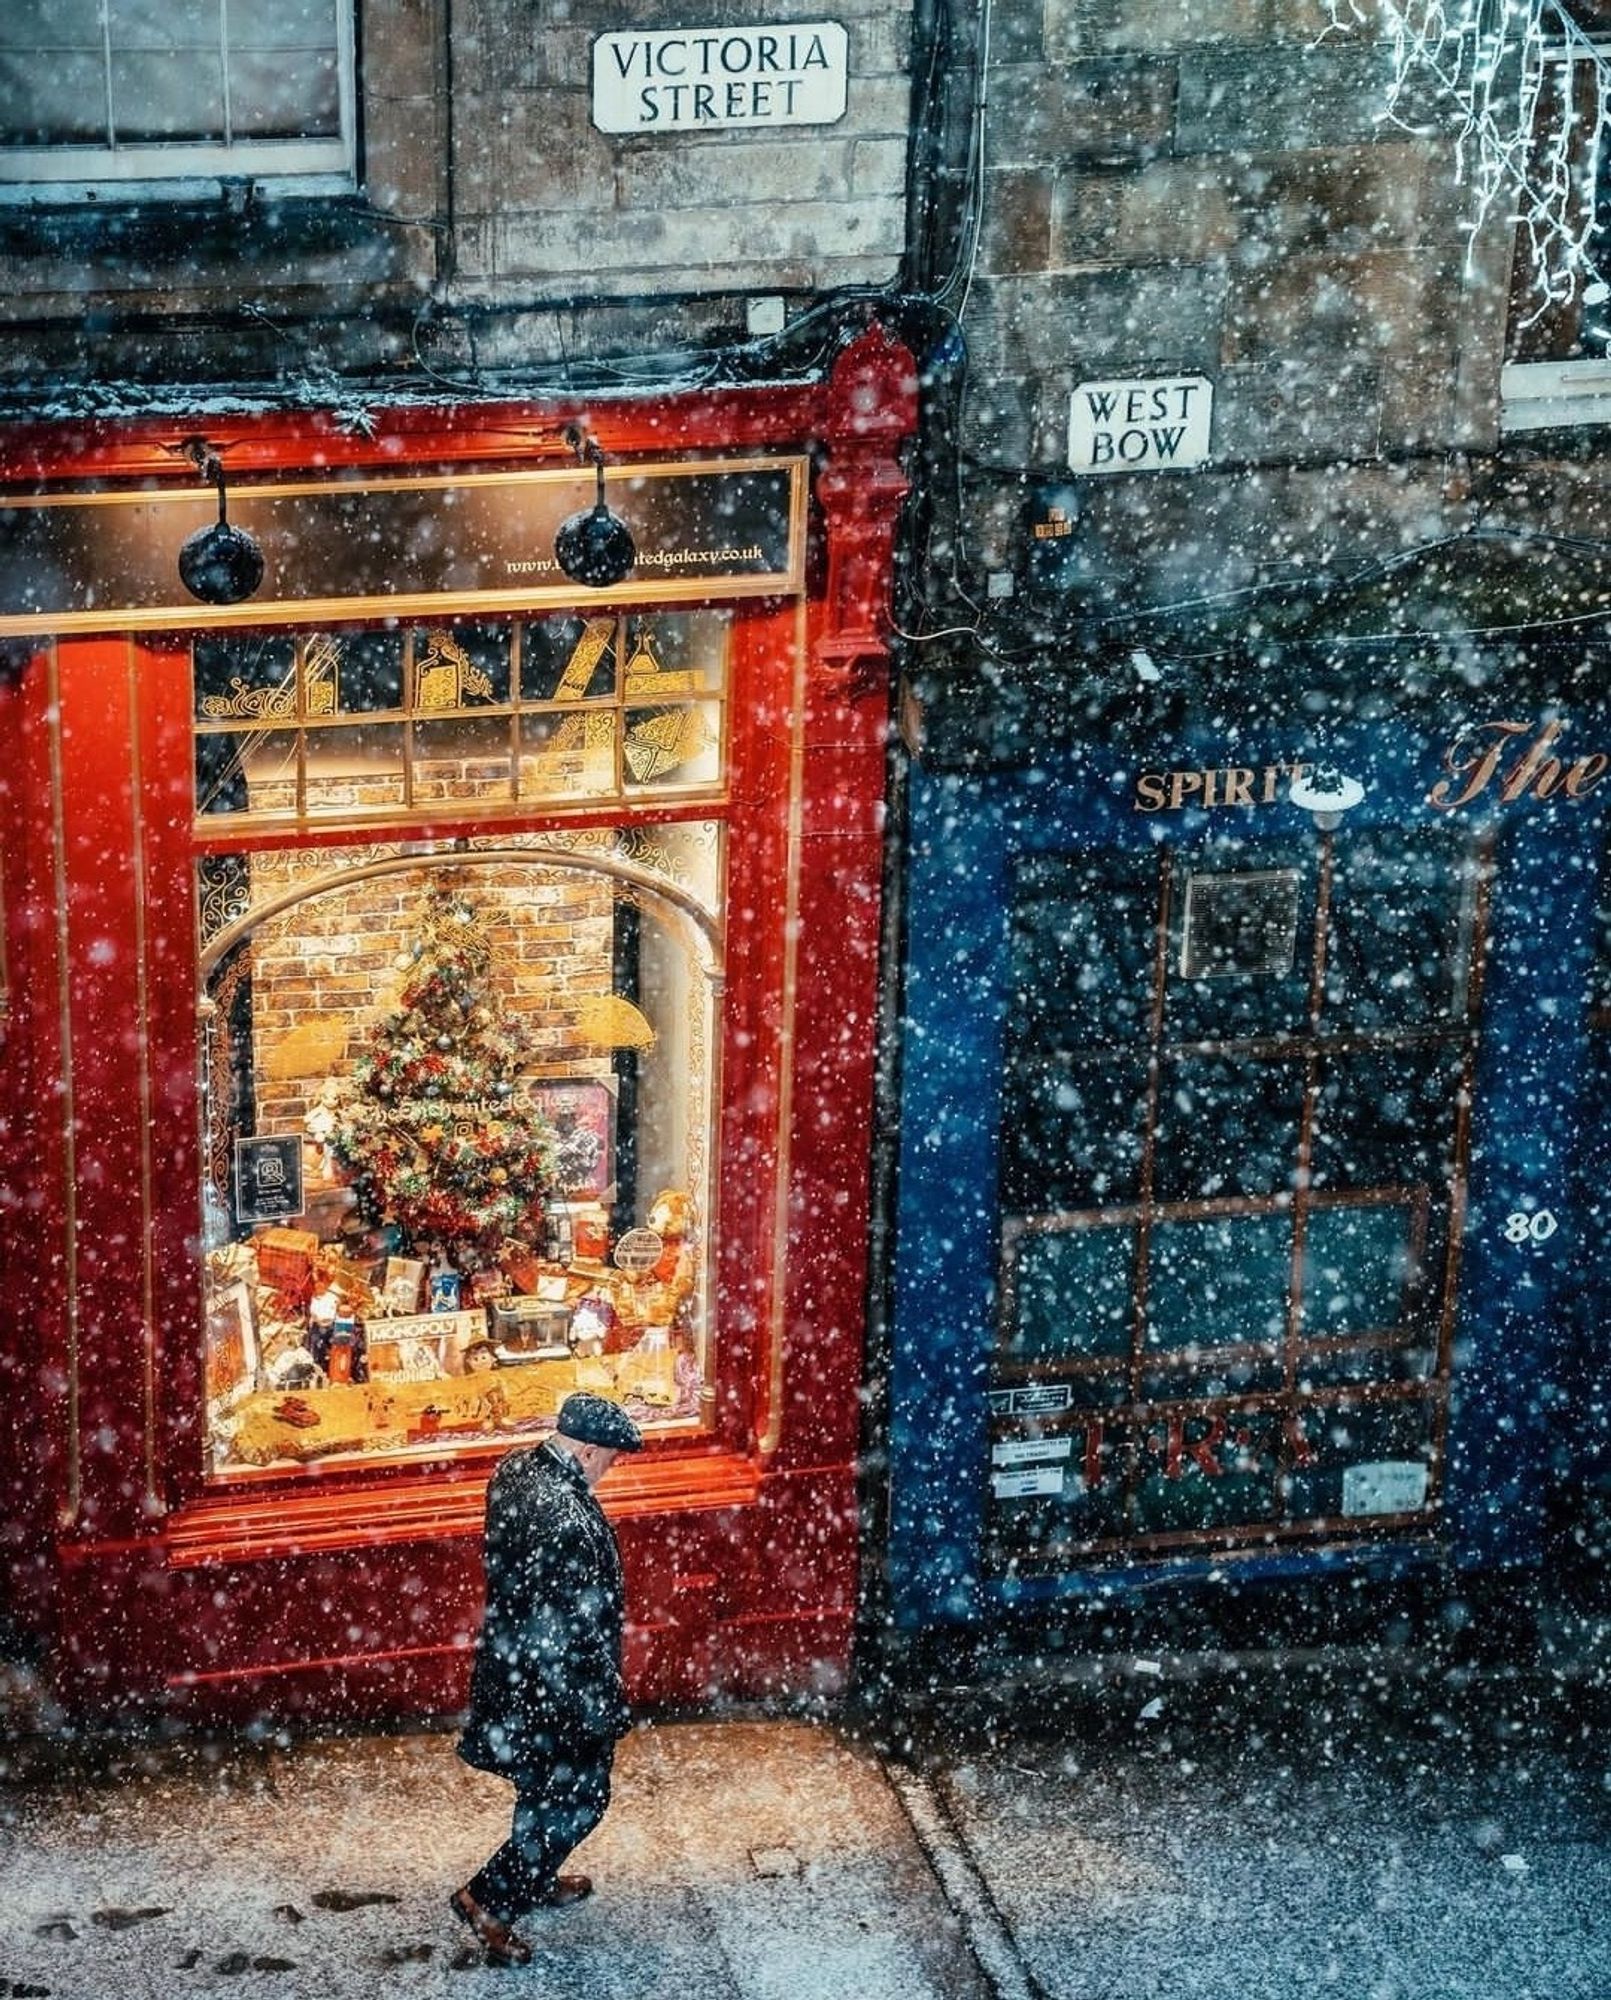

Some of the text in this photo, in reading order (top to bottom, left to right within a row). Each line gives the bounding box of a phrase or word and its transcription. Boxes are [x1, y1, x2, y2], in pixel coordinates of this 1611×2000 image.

[611, 34, 830, 79] VICTORIA
[639, 80, 803, 122] STREET
[1086, 385, 1199, 422] WEST
[1089, 427, 1188, 465] BOW
[1430, 719, 1610, 810] The
[1504, 1209, 1558, 1243] 80
[371, 1319, 457, 1342] MONOPOLY
